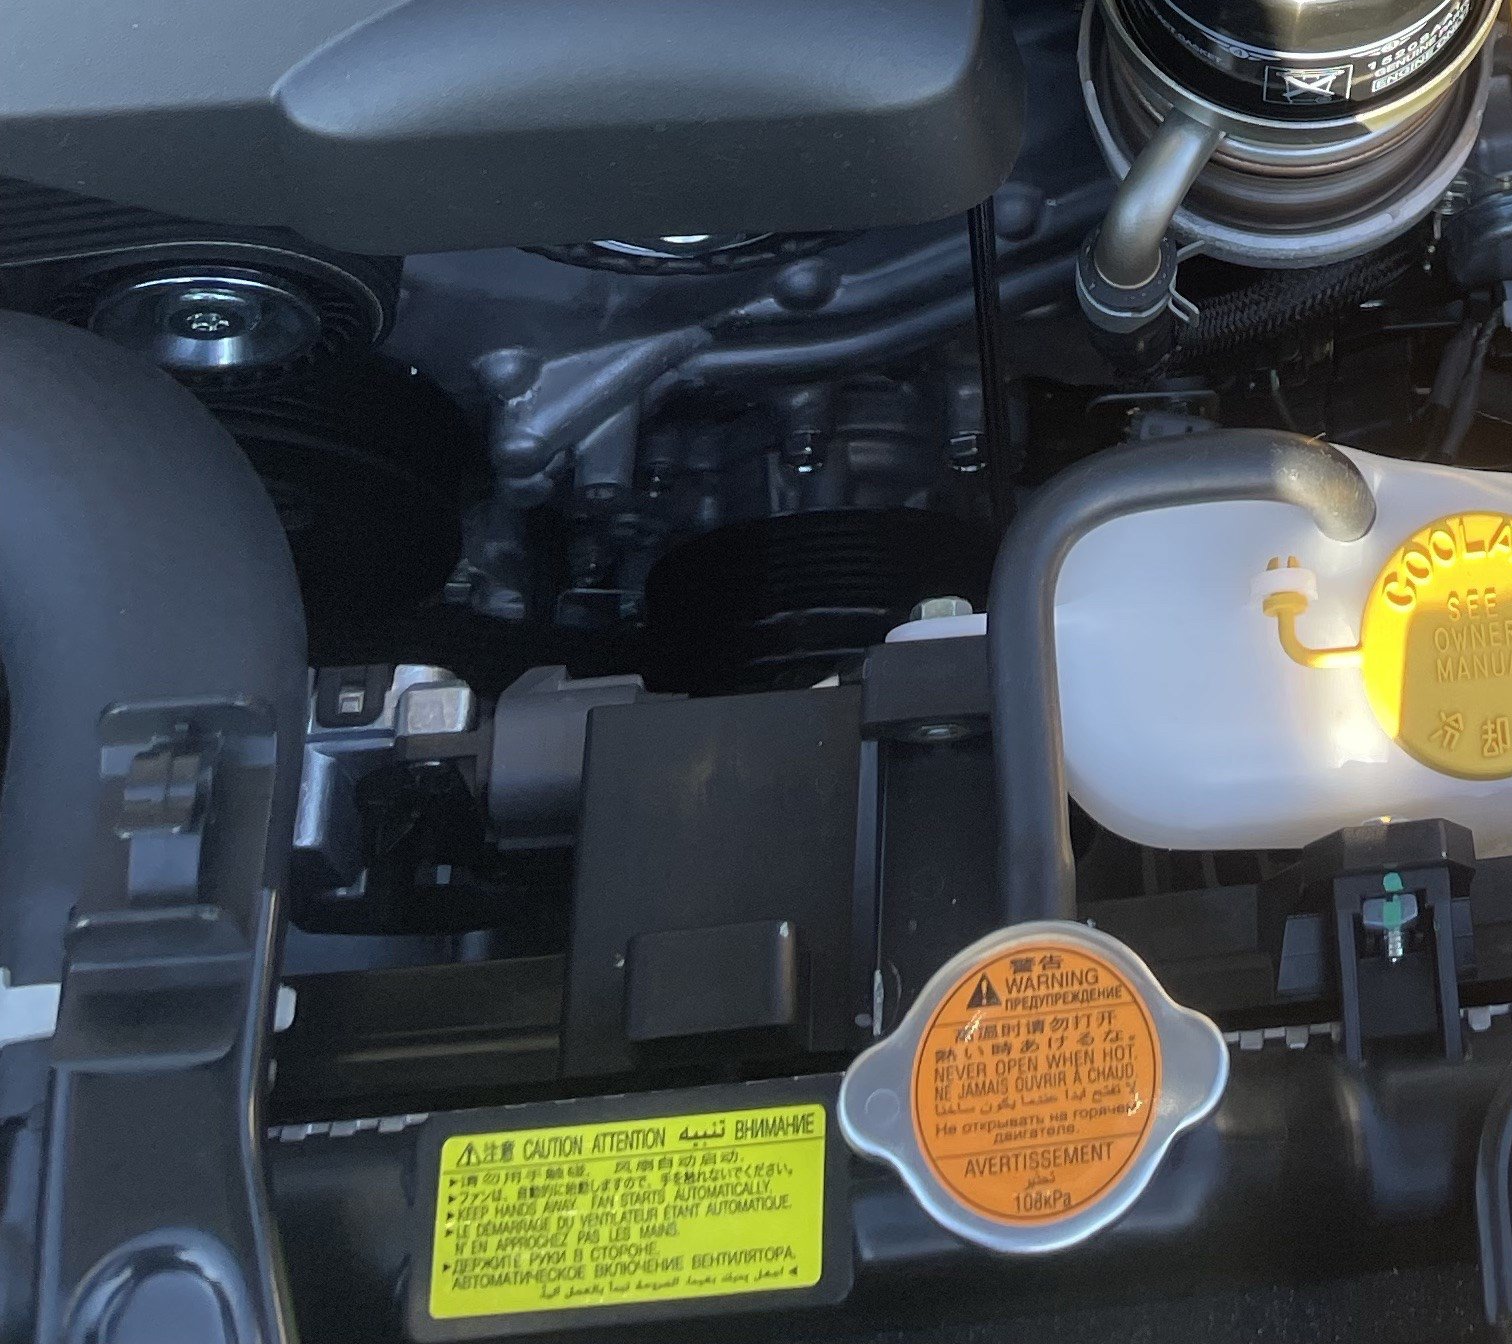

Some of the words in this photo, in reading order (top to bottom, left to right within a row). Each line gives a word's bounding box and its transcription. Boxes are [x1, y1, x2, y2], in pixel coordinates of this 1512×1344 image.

[1374, 33, 1437, 78] GENUINE
[1446, 588, 1499, 622] SEE
[1004, 983, 1123, 1011] ПРЕДУПРЕЖДЕНИЕ
[1005, 967, 1099, 995] WARNING
[934, 1063, 987, 1083] NEVER
[995, 1056, 1038, 1076] OPEN
[1046, 1049, 1095, 1069] WHEN
[934, 1085, 949, 1102] NE
[957, 1077, 1009, 1099] JAMAIS
[1015, 1070, 1067, 1093] OUVRIR
[523, 1134, 584, 1161] CAUTION
[591, 1127, 666, 1154] ATTENTION
[734, 1112, 816, 1140] ВНИМАНИЕ
[935, 1123, 957, 1137] Не
[961, 1114, 1044, 1135] открывать
[964, 1141, 1115, 1179] AVERTISSEMENT
[457, 1204, 489, 1221] KEEP
[591, 1193, 615, 1210] FAN
[620, 1188, 666, 1207] STARTS
[557, 1215, 575, 1230] DU
[580, 1207, 658, 1229] VENTILATEUR
[578, 1228, 600, 1245] PAS
[608, 1225, 631, 1243] LES
[453, 1252, 521, 1276] ДЕРЖИТЕ
[529, 1249, 567, 1266] РУКИ
[453, 1264, 586, 1290] АВТОМАТИЧЕСКОЕ
[594, 1255, 685, 1279] ВКЛЮЧЕНИЕ
